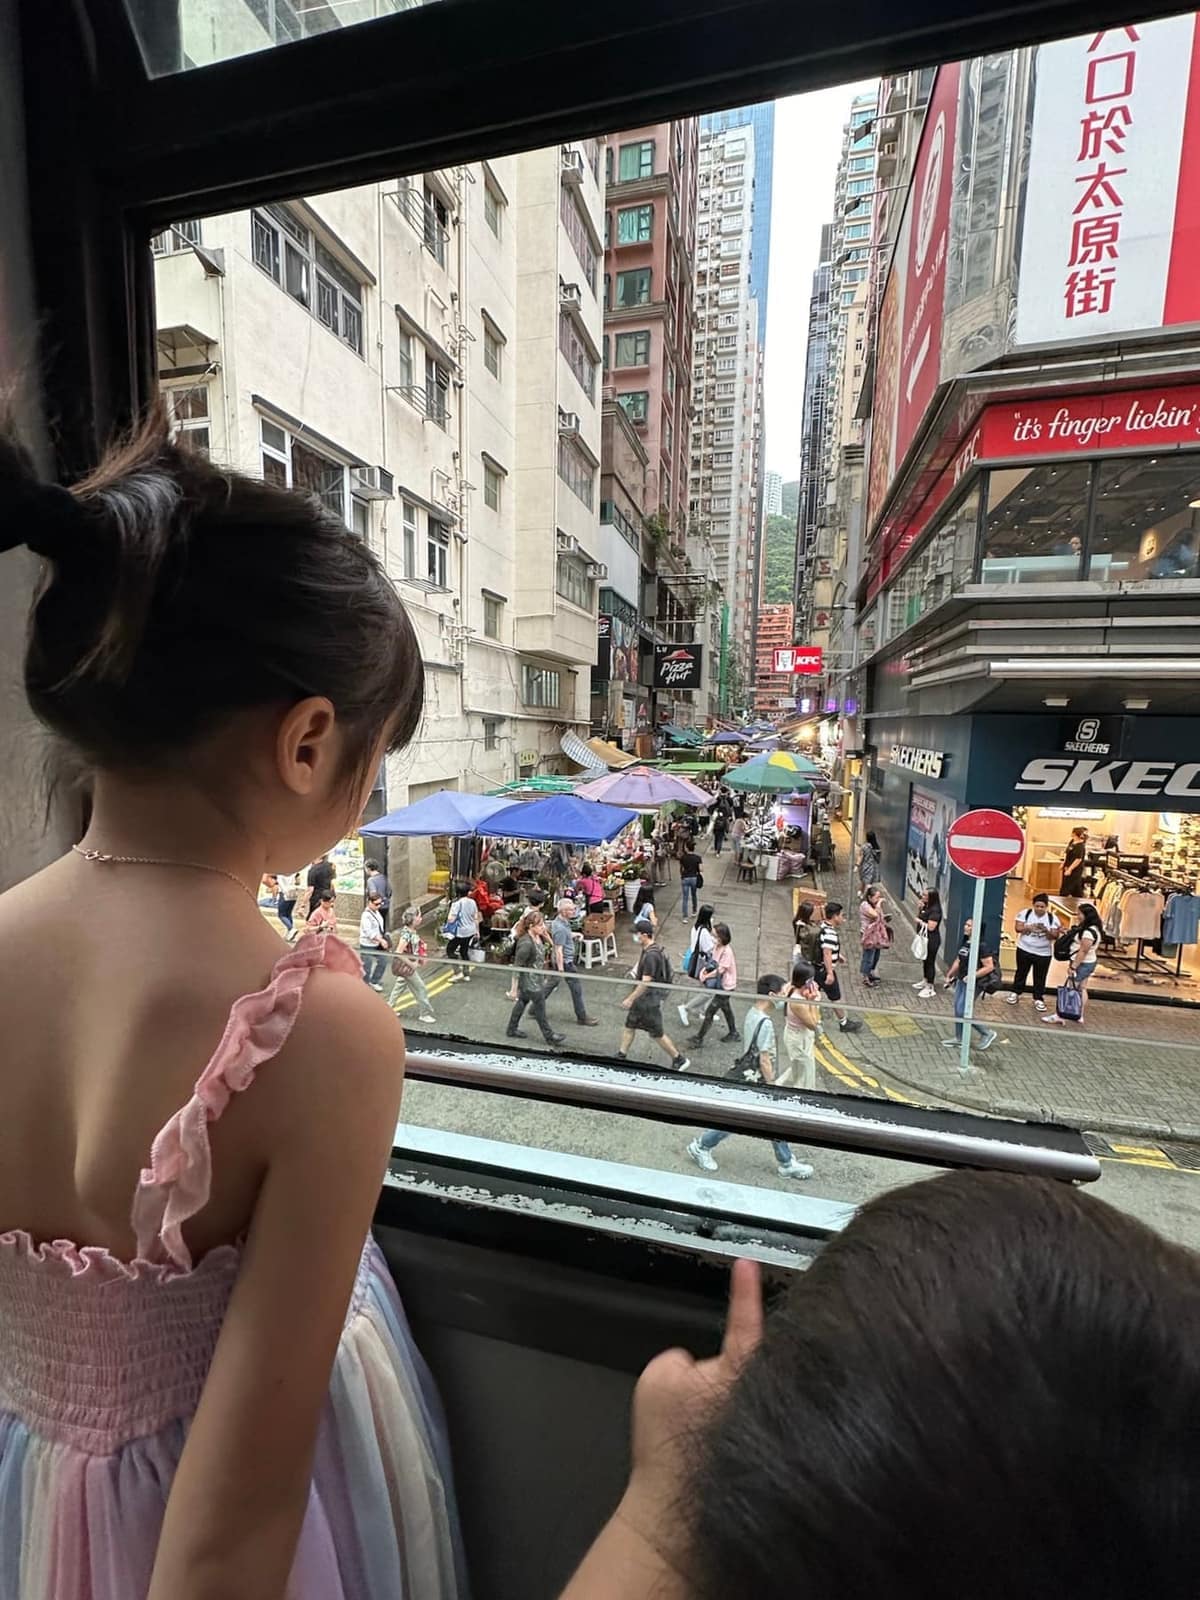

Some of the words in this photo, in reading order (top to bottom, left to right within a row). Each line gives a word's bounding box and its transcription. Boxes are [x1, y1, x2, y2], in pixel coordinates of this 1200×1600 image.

[1047, 409, 1122, 445] finger
[660, 660, 694, 677] Pizza
[796, 655, 820, 665] KFC
[665, 670, 693, 685] Hut
[1064, 740, 1110, 755] SKECHERS
[889, 744, 945, 780] SKECHERS
[1014, 757, 1200, 798] SKEC
